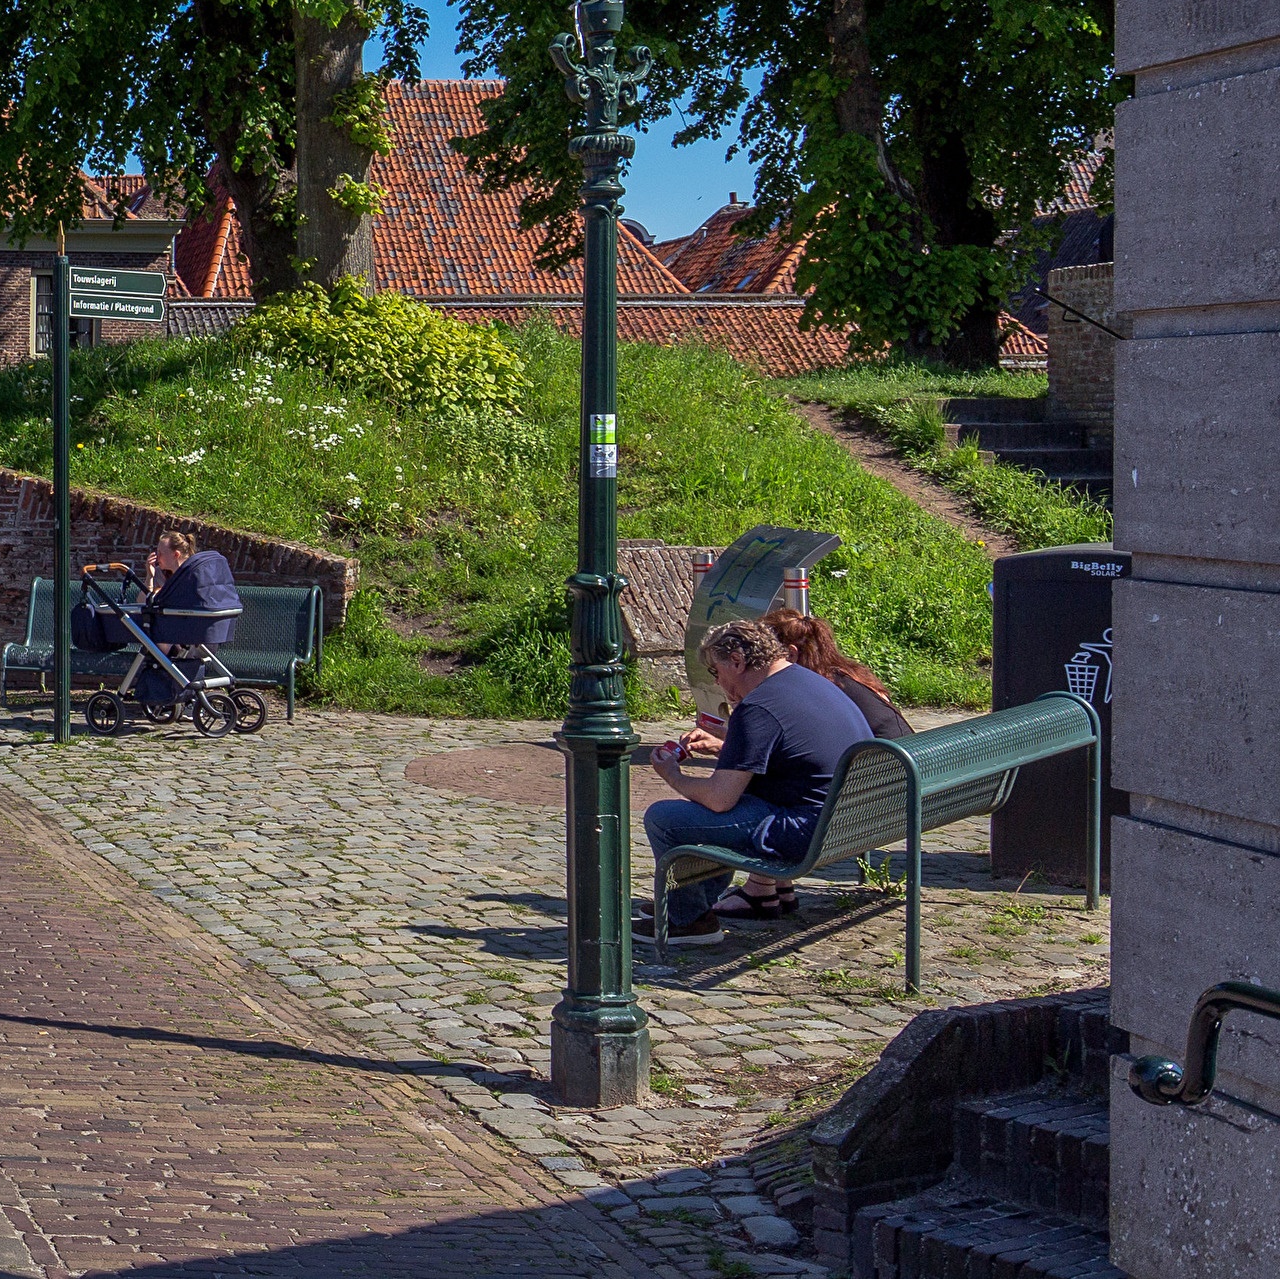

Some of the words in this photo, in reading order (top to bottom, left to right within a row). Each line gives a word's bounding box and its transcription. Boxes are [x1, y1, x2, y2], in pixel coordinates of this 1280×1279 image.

[73, 274, 117, 287] Touwslagerij
[73, 300, 110, 311] Informatie
[114, 302, 154, 315] Plattegrond
[1071, 561, 1123, 572] BigBelly
